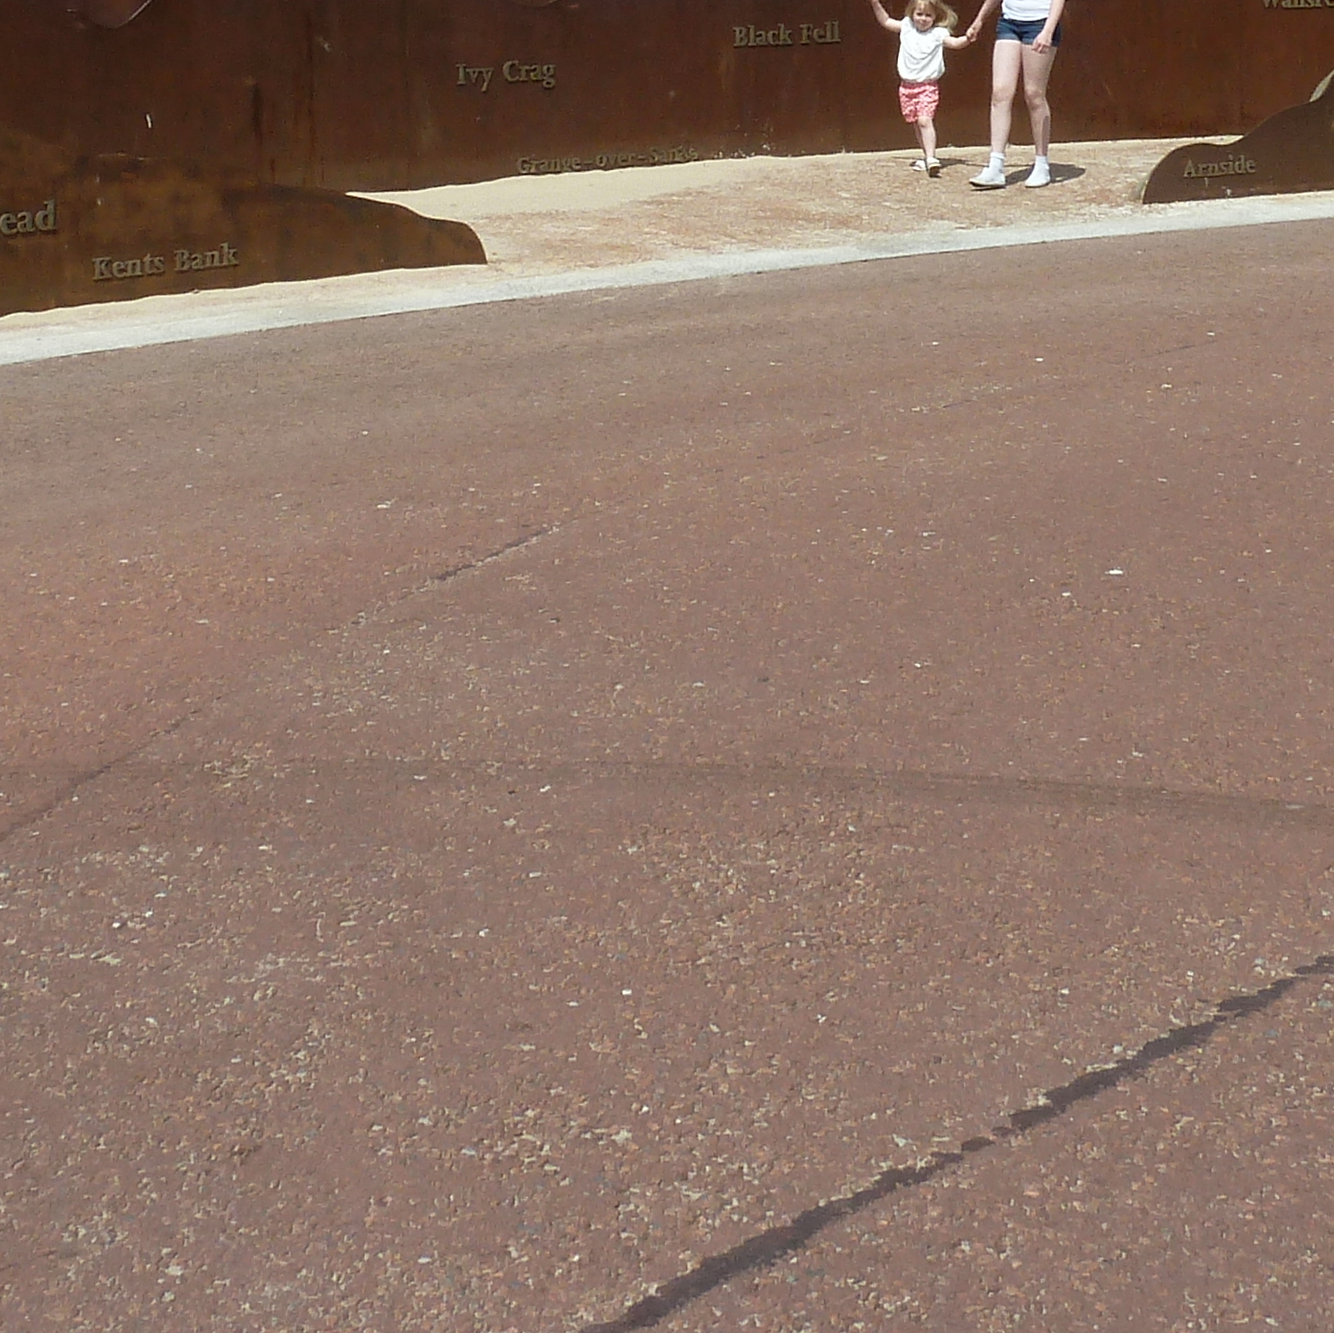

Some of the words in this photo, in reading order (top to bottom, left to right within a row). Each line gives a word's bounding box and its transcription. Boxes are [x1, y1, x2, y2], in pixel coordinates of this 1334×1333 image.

[733, 23, 793, 48] Black
[800, 21, 841, 44] Fell
[456, 62, 495, 92] Ivy
[502, 59, 556, 88] Crag
[1183, 154, 1256, 177] Arnside
[92, 253, 165, 281] Kents
[174, 242, 239, 271] Bank
